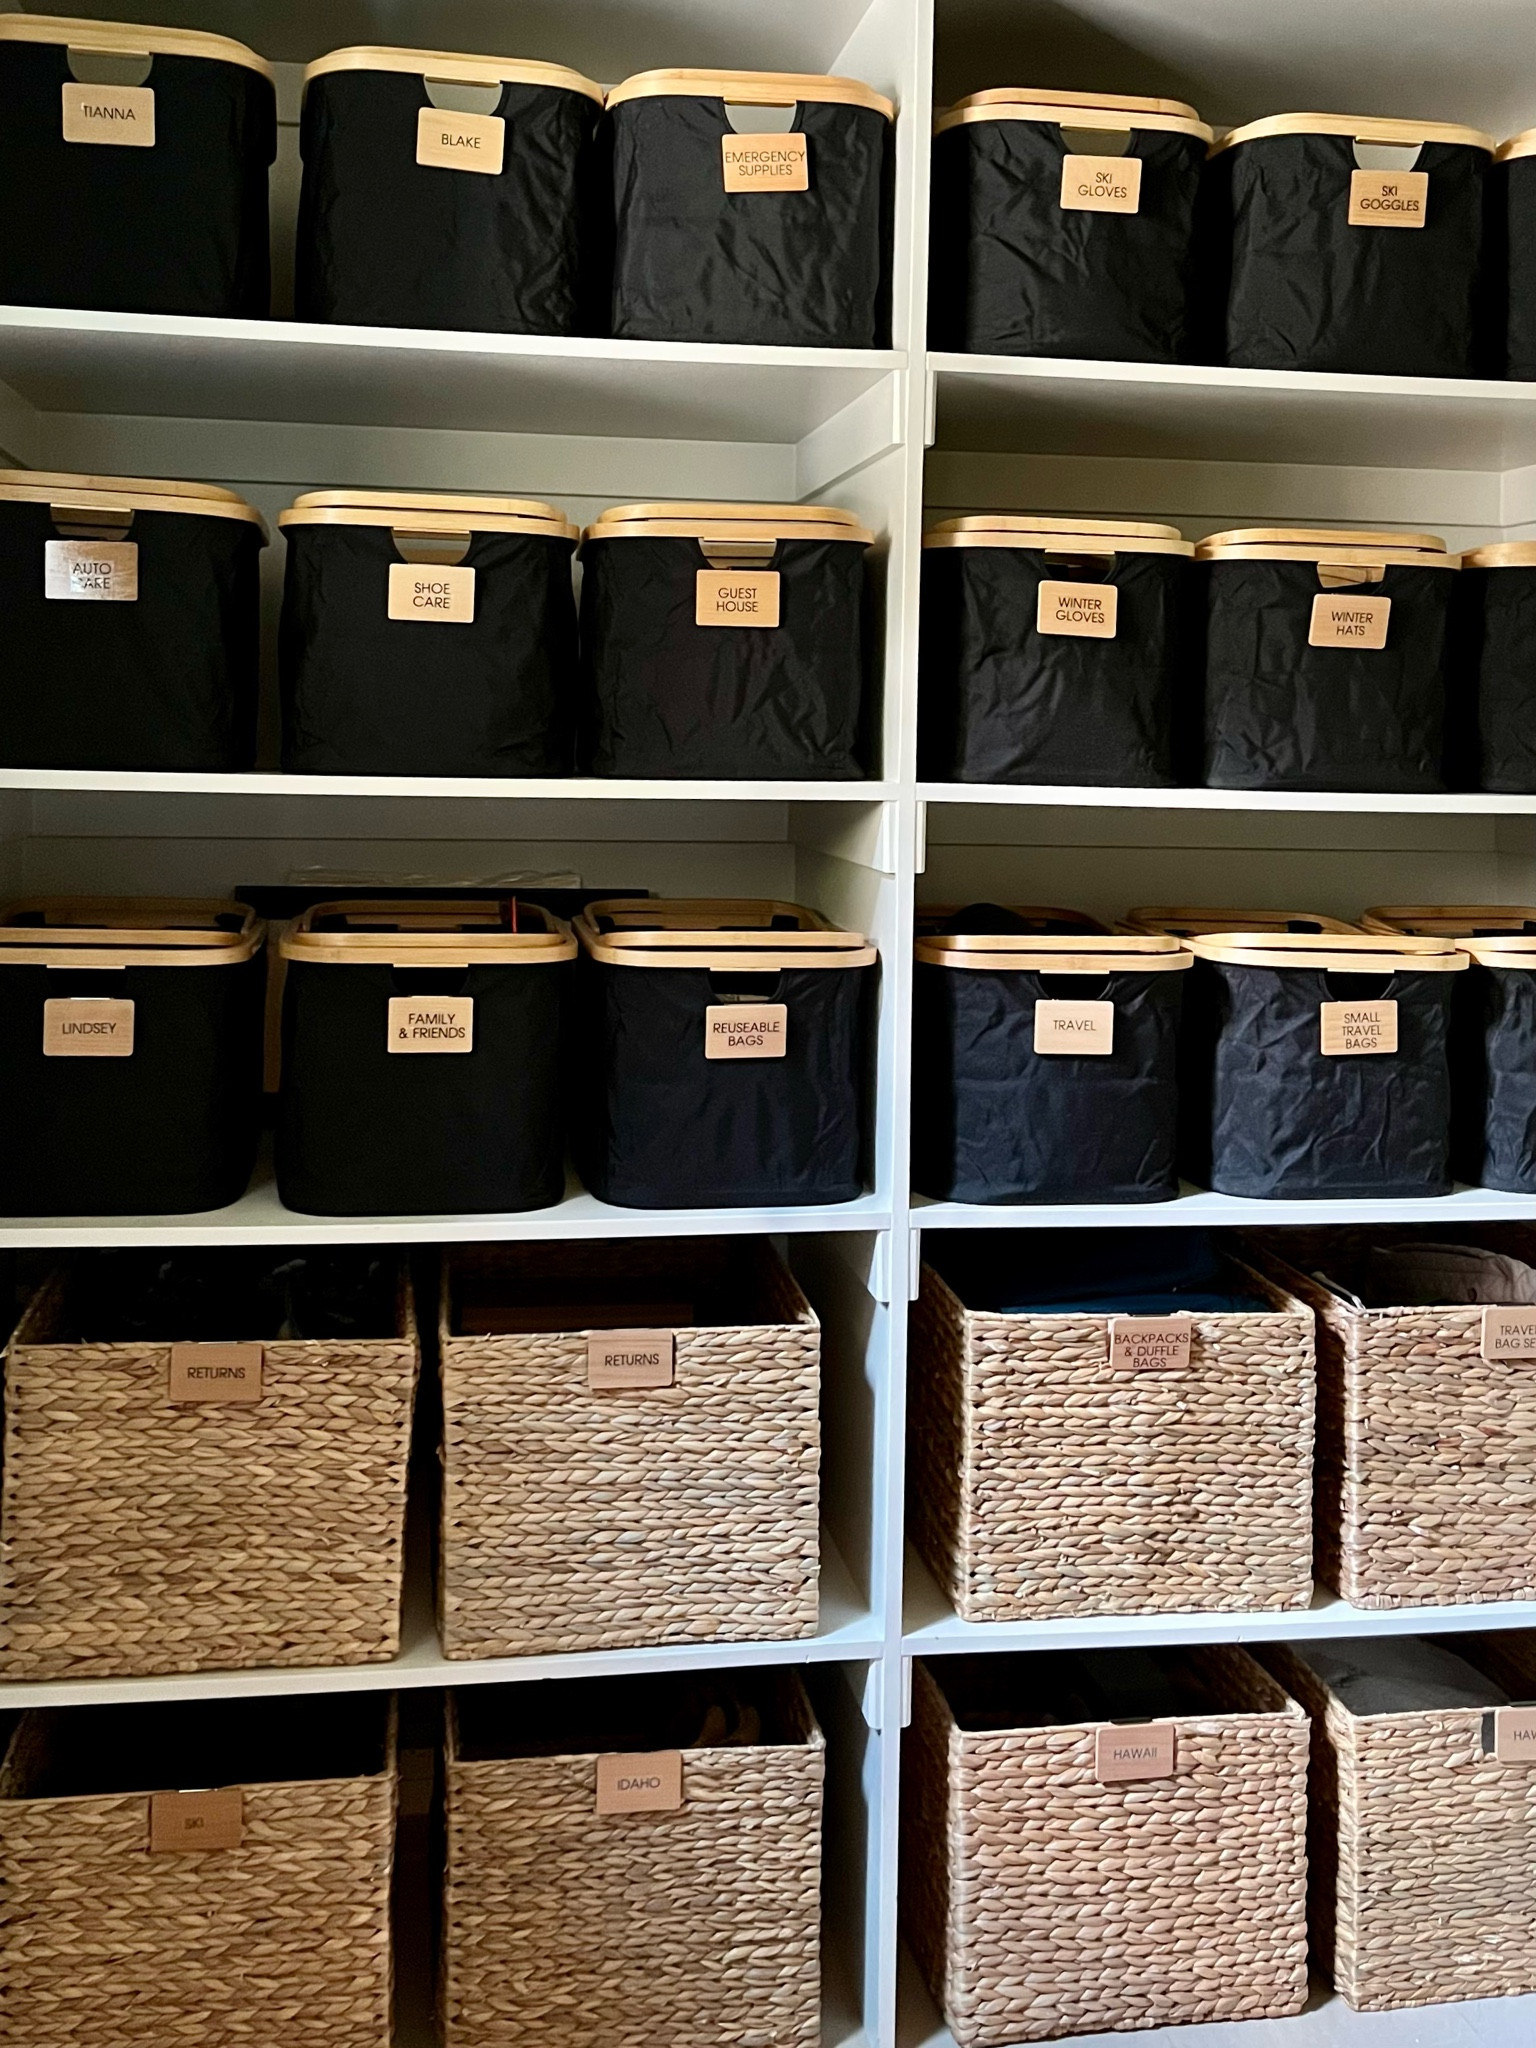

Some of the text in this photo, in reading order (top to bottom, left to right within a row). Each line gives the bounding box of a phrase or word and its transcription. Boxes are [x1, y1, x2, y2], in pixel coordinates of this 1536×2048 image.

[83, 104, 136, 121] TIANNA
[441, 133, 481, 149] BLAKE
[725, 150, 805, 164] EMERGENCY
[738, 164, 793, 176] SUPPLIES
[1095, 172, 1112, 184] SKI
[1078, 184, 1127, 198] GLOVES
[1382, 185, 1398, 197] SKI
[1360, 198, 1419, 212] GOGGLES
[72, 562, 112, 575] AUTO
[414, 582, 450, 595] SHOE
[718, 587, 757, 599] GUEST
[412, 595, 450, 609] CARE
[716, 600, 759, 613] HOUSE
[1058, 597, 1102, 610] WINTER
[1055, 610, 1105, 623] GLOVES
[1331, 611, 1374, 624] WINTER
[1336, 625, 1366, 636] HATS
[408, 1013, 456, 1025] FAMILY
[1343, 1012, 1381, 1024] SMALL
[62, 1022, 117, 1035] LINDSEY
[713, 1021, 780, 1034] REUSEABLE
[1053, 1020, 1096, 1031] TRAVEL
[1342, 1025, 1382, 1037] TRAVEL
[398, 1027, 466, 1039] & FRIENDS
[728, 1035, 764, 1047] BAGS
[1345, 1038, 1377, 1049] BAGS
[1114, 1333, 1189, 1345] BACKPACKS
[1495, 1338, 1520, 1349] BAG
[1124, 1346, 1179, 1356] & DUFFLE
[603, 1353, 660, 1367] RETURNS
[1132, 1357, 1167, 1368] BAGS
[187, 1366, 246, 1379] RETURNS
[1113, 1747, 1157, 1760] HAWAII
[617, 1777, 661, 1791] IDAHO
